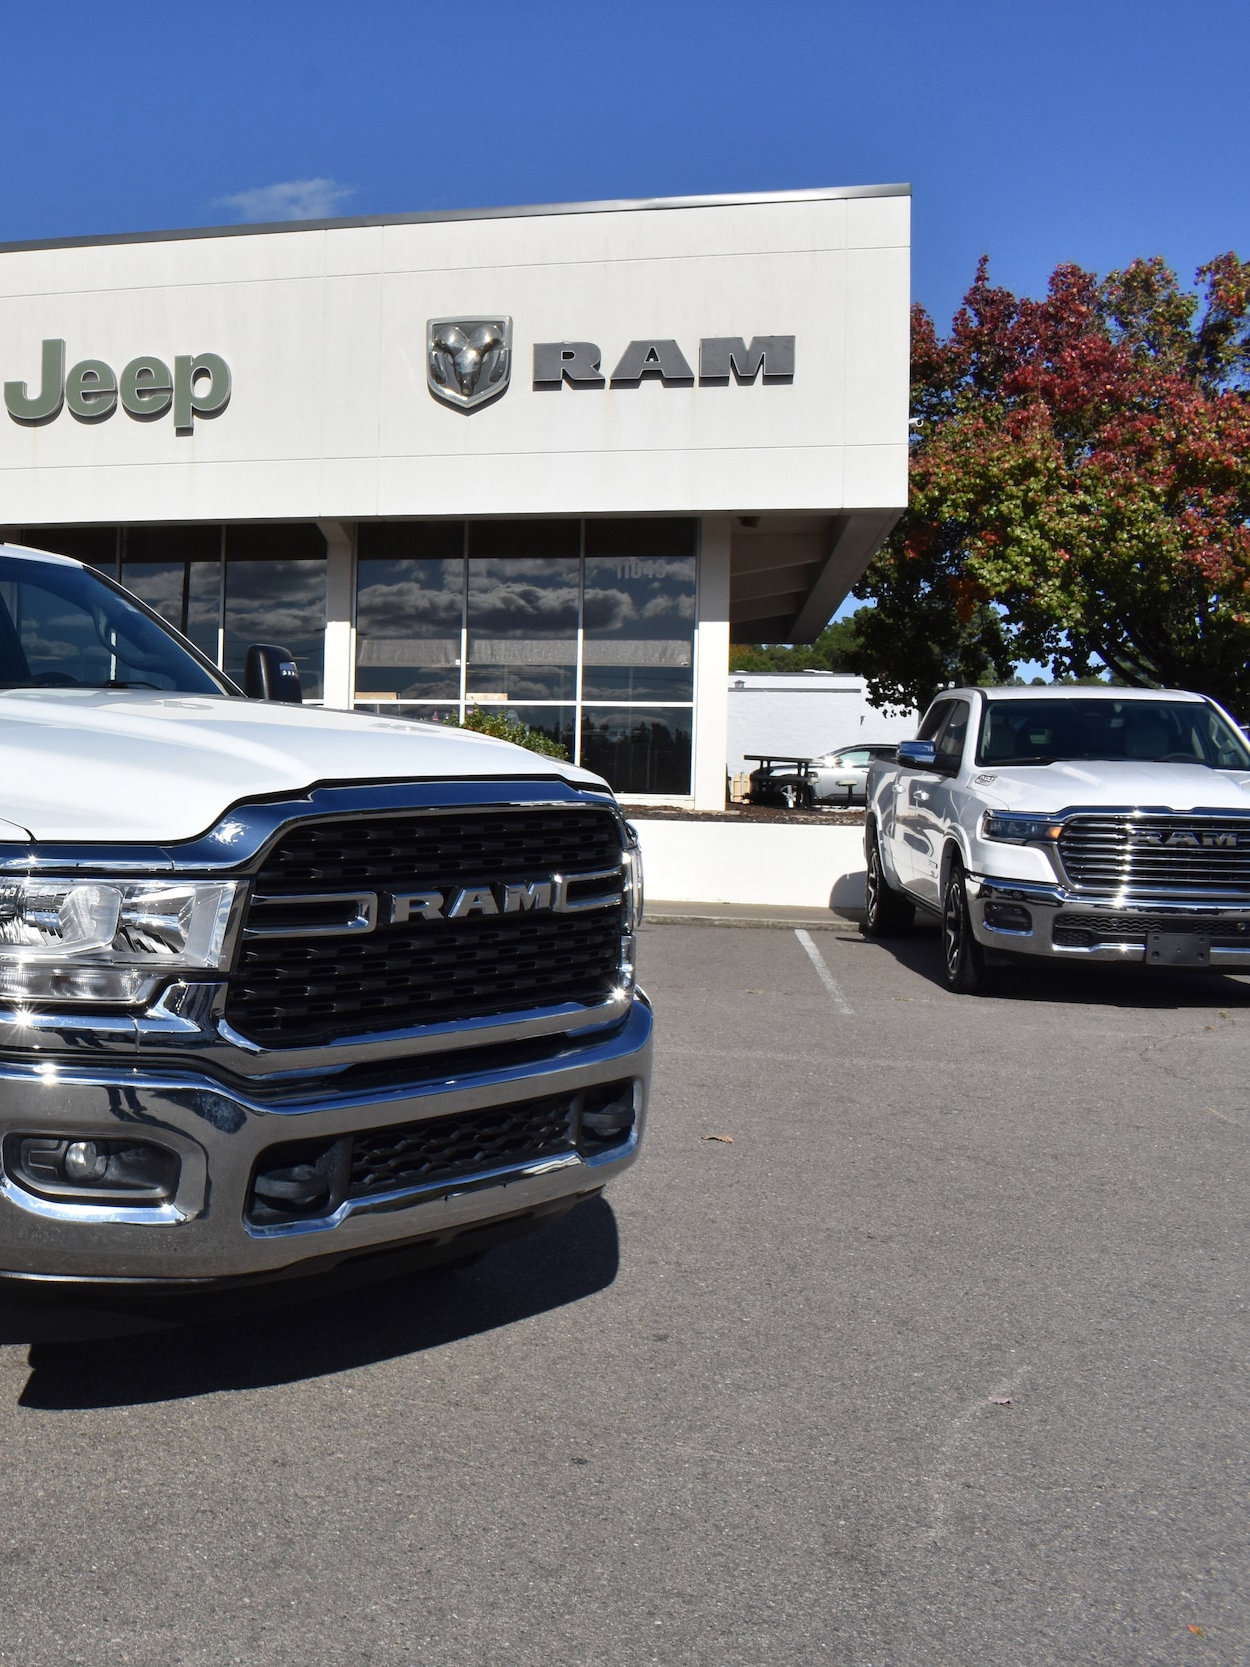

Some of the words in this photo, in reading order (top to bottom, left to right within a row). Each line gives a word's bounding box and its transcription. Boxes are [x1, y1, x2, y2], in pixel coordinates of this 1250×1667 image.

[532, 335, 796, 387] RAM
[4, 338, 232, 434] Jeep
[1127, 830, 1238, 847] RAM
[390, 881, 551, 924] RAM
